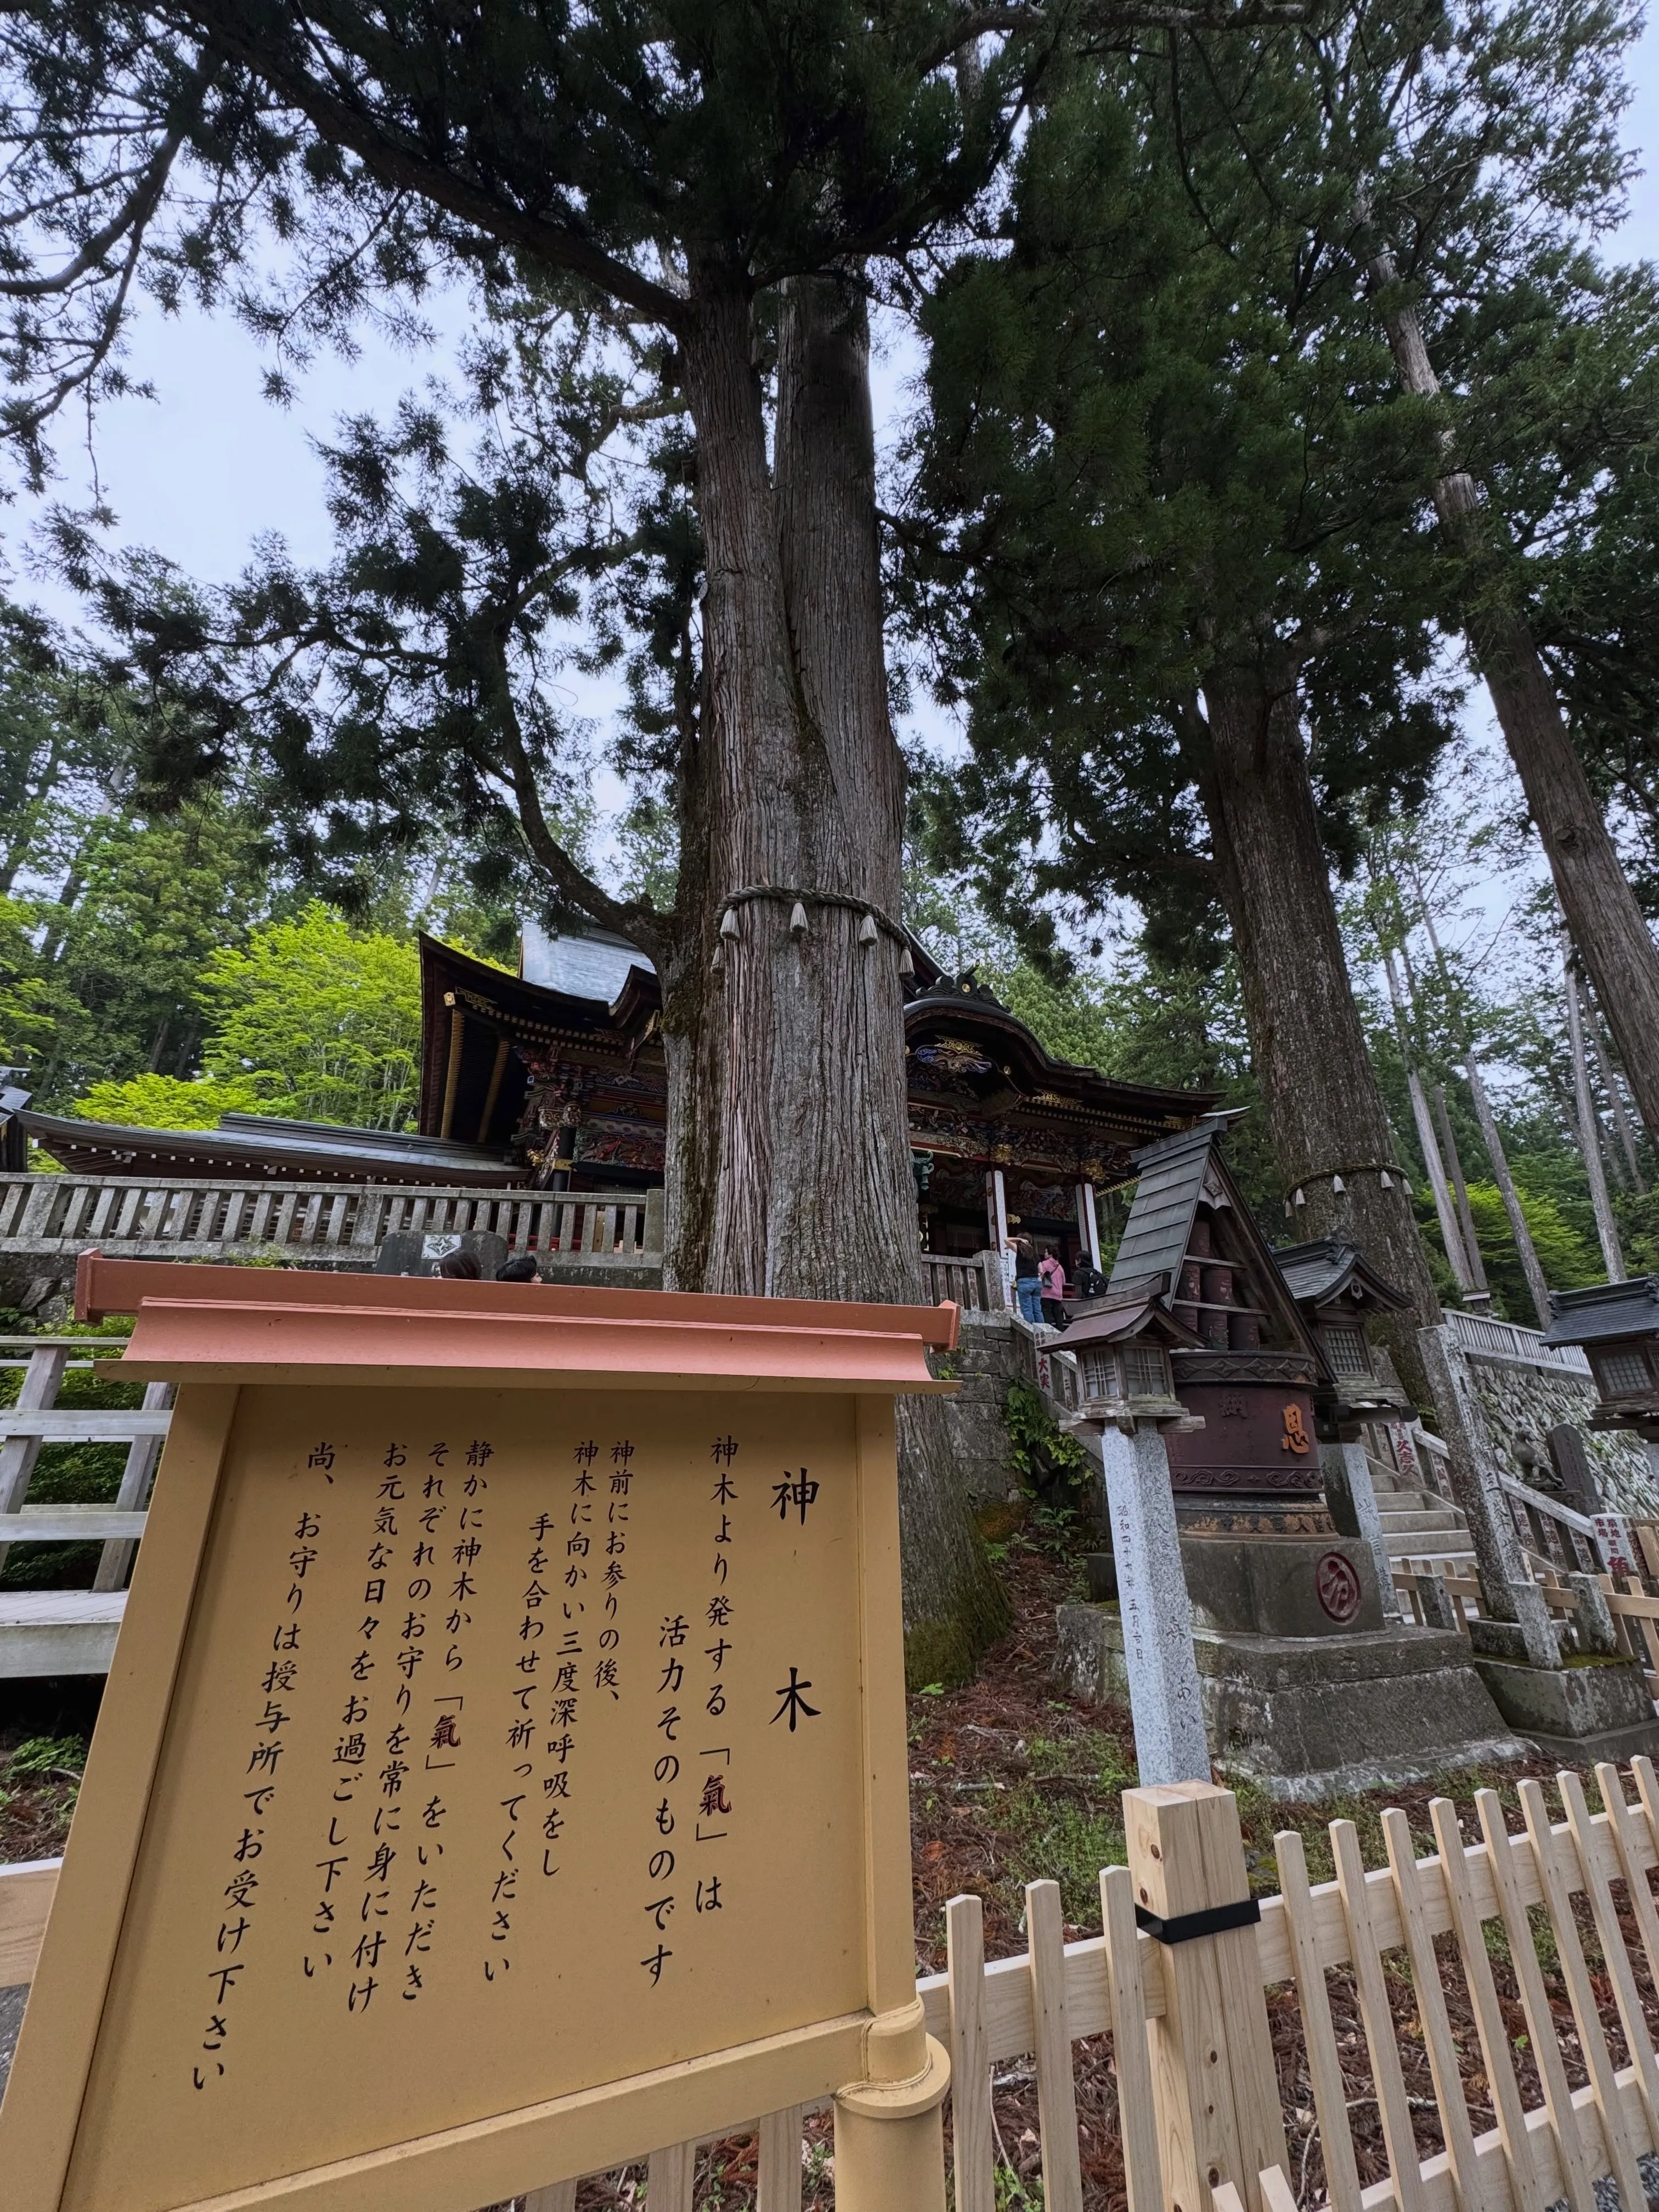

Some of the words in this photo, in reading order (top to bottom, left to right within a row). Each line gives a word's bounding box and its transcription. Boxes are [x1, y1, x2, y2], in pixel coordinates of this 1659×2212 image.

[304, 1443, 406, 1977] お元気な日々をお過ごし下さい
[349, 1442, 449, 2012] それぞれのお守りを常に身に付け
[485, 1513, 554, 1981] 手を合わせて祈ってください
[543, 1440, 599, 1876] 神木に向かい三度深呼吸をし
[594, 1440, 634, 1700] 神前にお参りの後、
[641, 1615, 689, 1987] 活力そのものです
